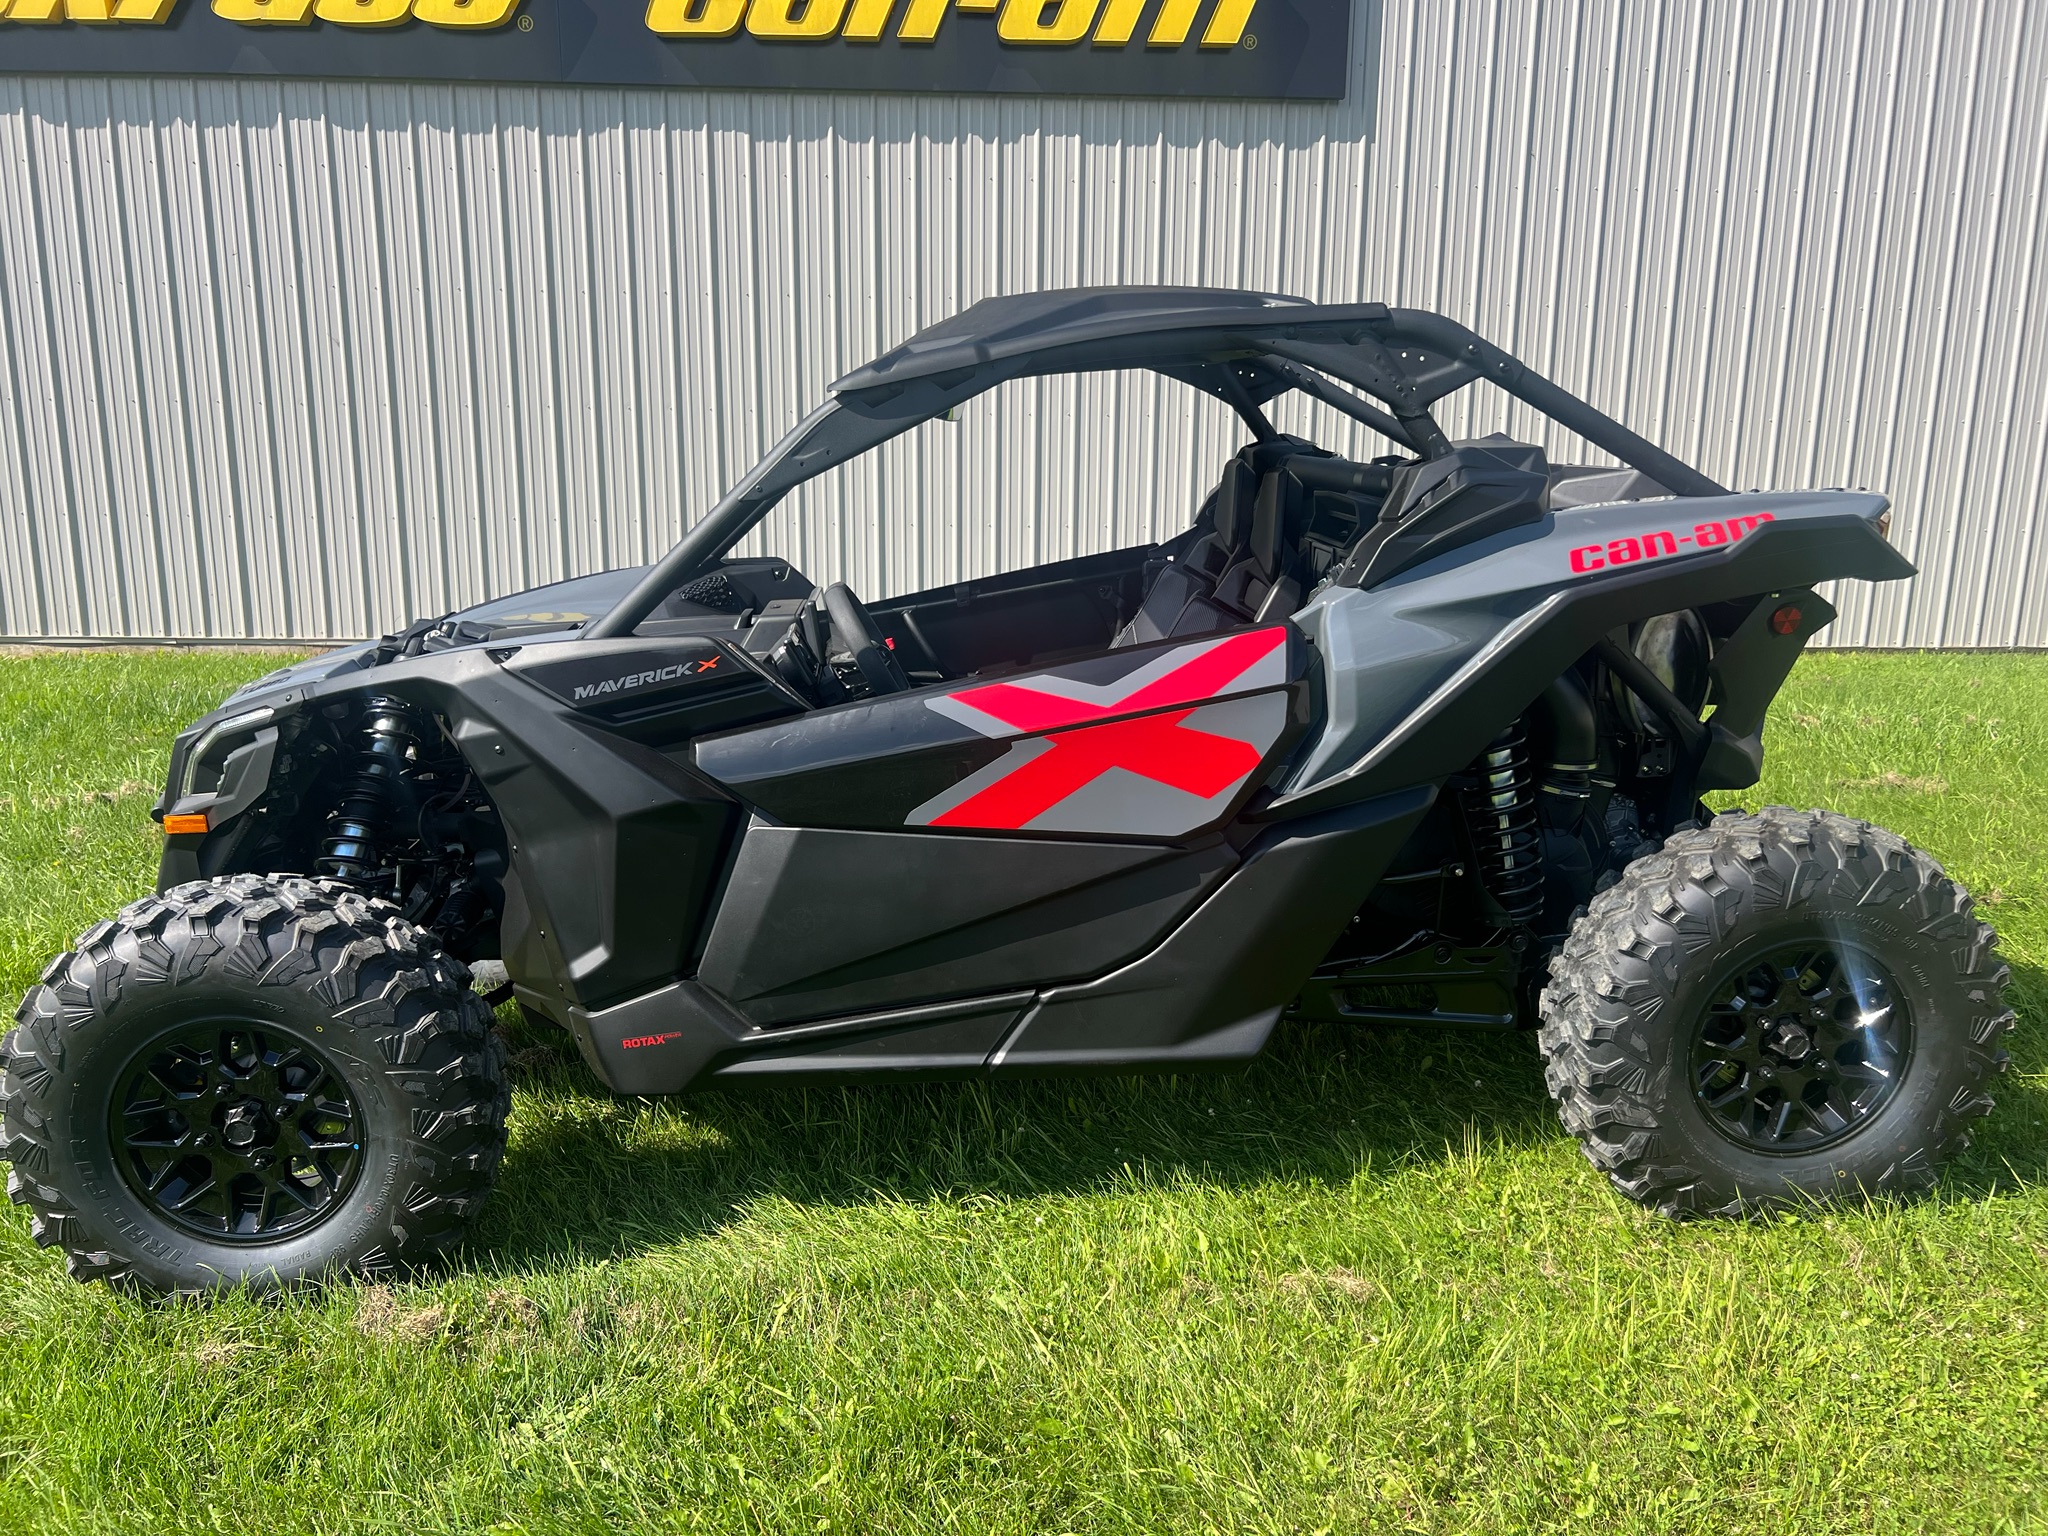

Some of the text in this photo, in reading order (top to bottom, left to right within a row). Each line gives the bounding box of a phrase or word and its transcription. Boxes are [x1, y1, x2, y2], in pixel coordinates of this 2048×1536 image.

[1569, 512, 1775, 574] can-am
[574, 661, 694, 699] MAVERICK
[622, 1036, 665, 1049] ROTAX
[280, 1249, 312, 1267] RADIAL
